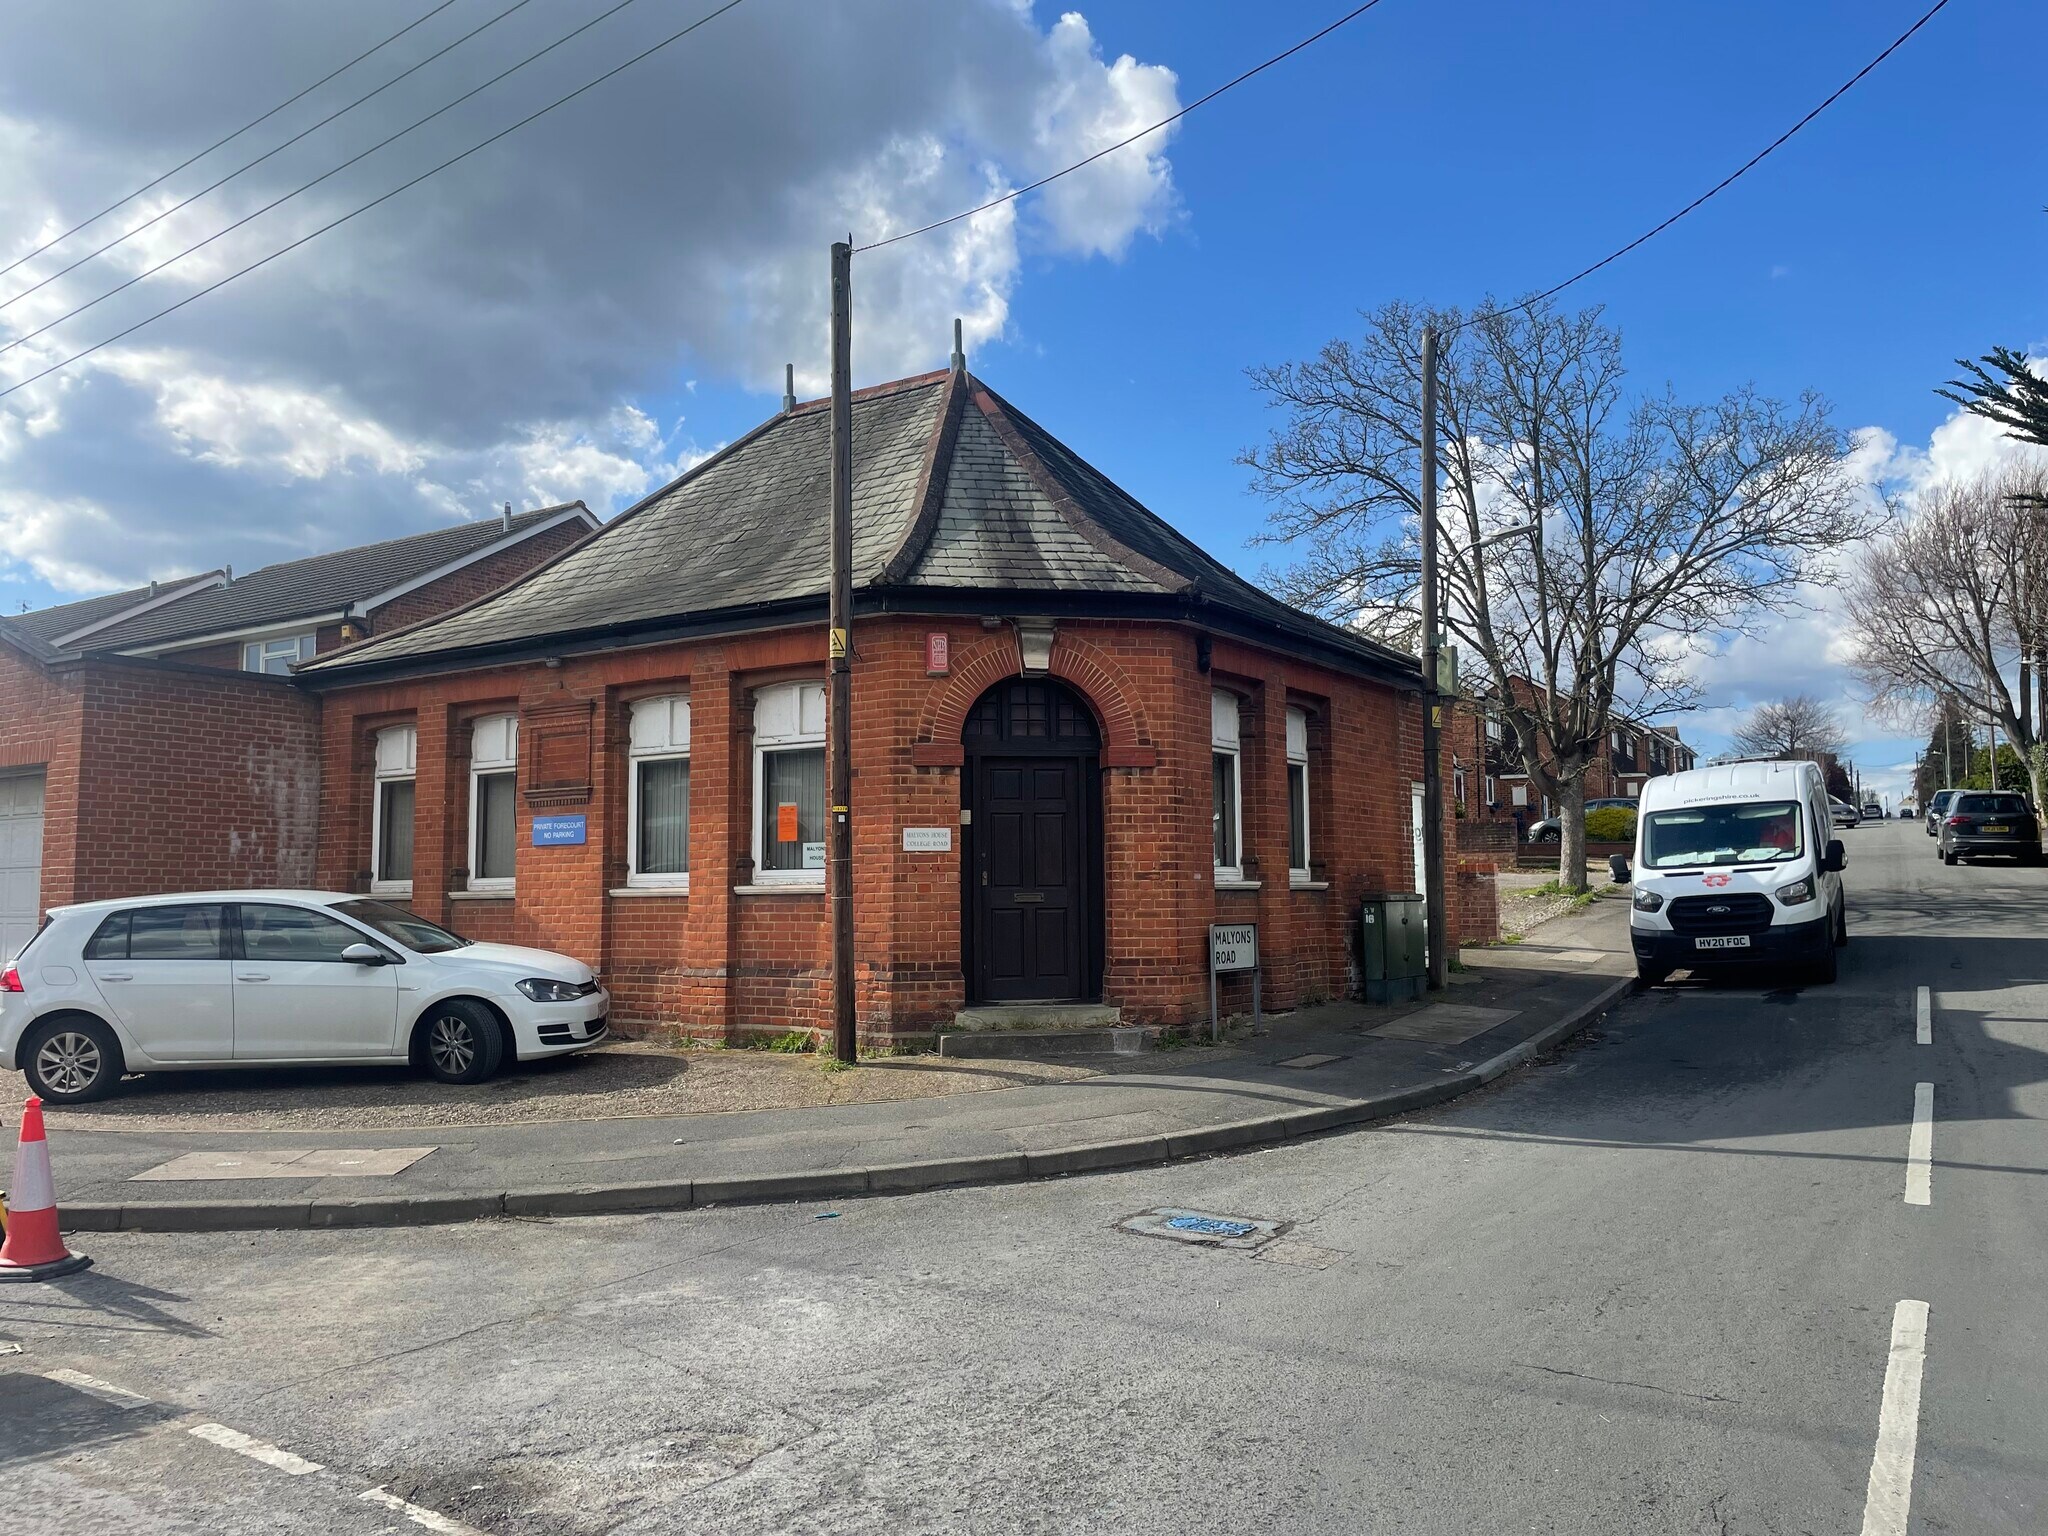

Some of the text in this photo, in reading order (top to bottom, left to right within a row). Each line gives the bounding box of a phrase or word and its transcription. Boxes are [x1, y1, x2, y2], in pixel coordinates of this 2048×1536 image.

[533, 821, 584, 830] PRIVATE FORECOURT
[906, 831, 949, 839] MALYONS HOUSE
[1215, 930, 1251, 945] MALYONS
[1699, 937, 1746, 948] HV20 FOC
[1215, 950, 1236, 964] ROAD
